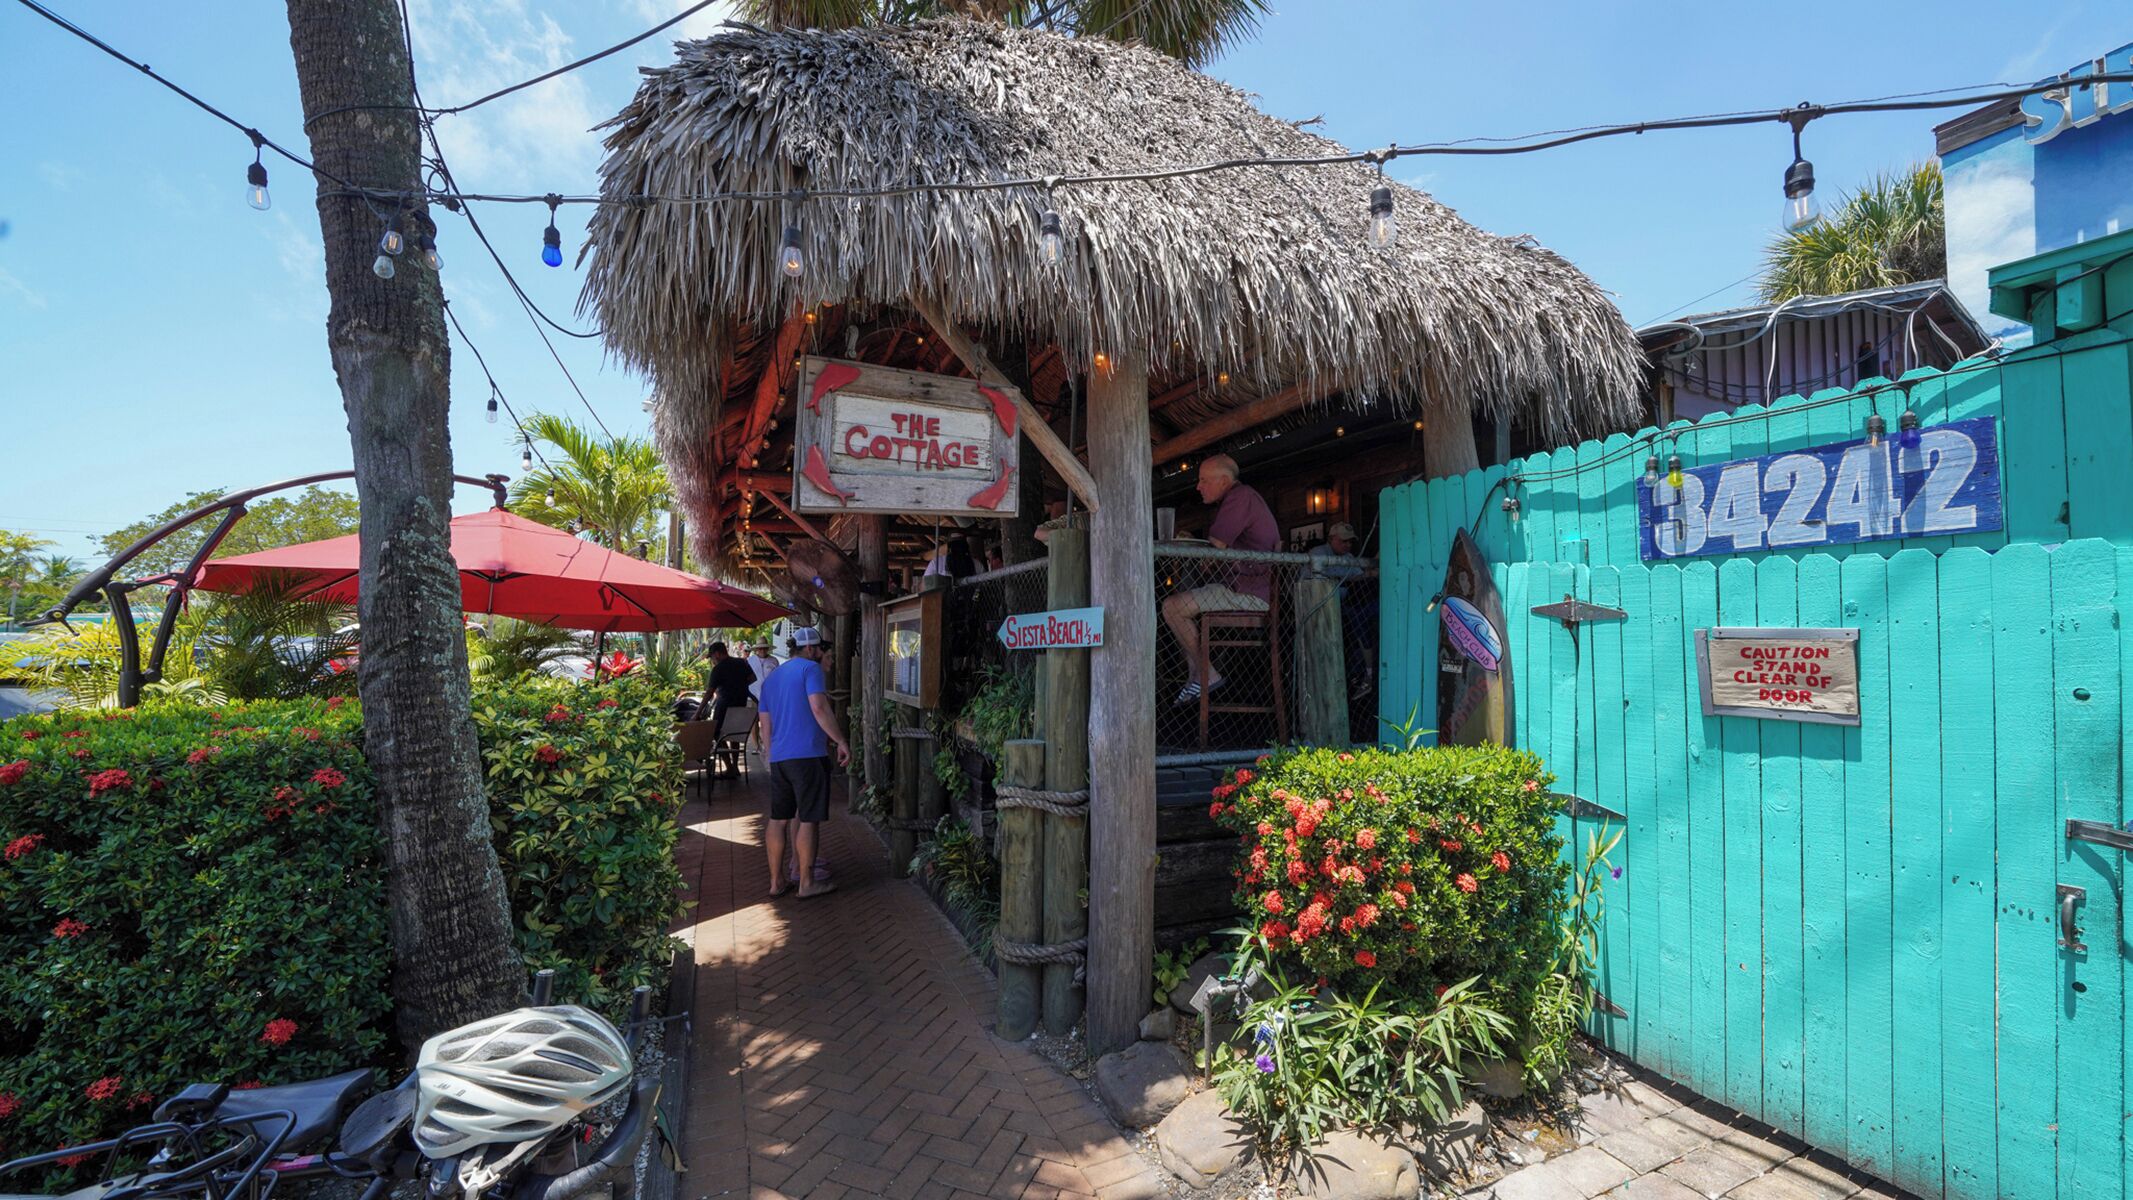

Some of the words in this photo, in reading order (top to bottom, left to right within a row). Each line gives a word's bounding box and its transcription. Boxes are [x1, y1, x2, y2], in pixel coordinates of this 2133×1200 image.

[891, 413, 941, 440] THE
[845, 424, 979, 472] COTTAGE
[1652, 429, 1978, 557] 34242
[1006, 616, 1048, 648] SIESTA
[1048, 615, 1083, 646] BEACH
[1445, 611, 1470, 643] BEACH
[1469, 641, 1490, 665] CLUB
[1740, 647, 1830, 659] CAUTION
[1734, 670, 1798, 686] CLEAR
[1806, 675, 1832, 689] OF
[1753, 660, 1821, 675] STAND
[1759, 689, 1814, 703] DOOR
